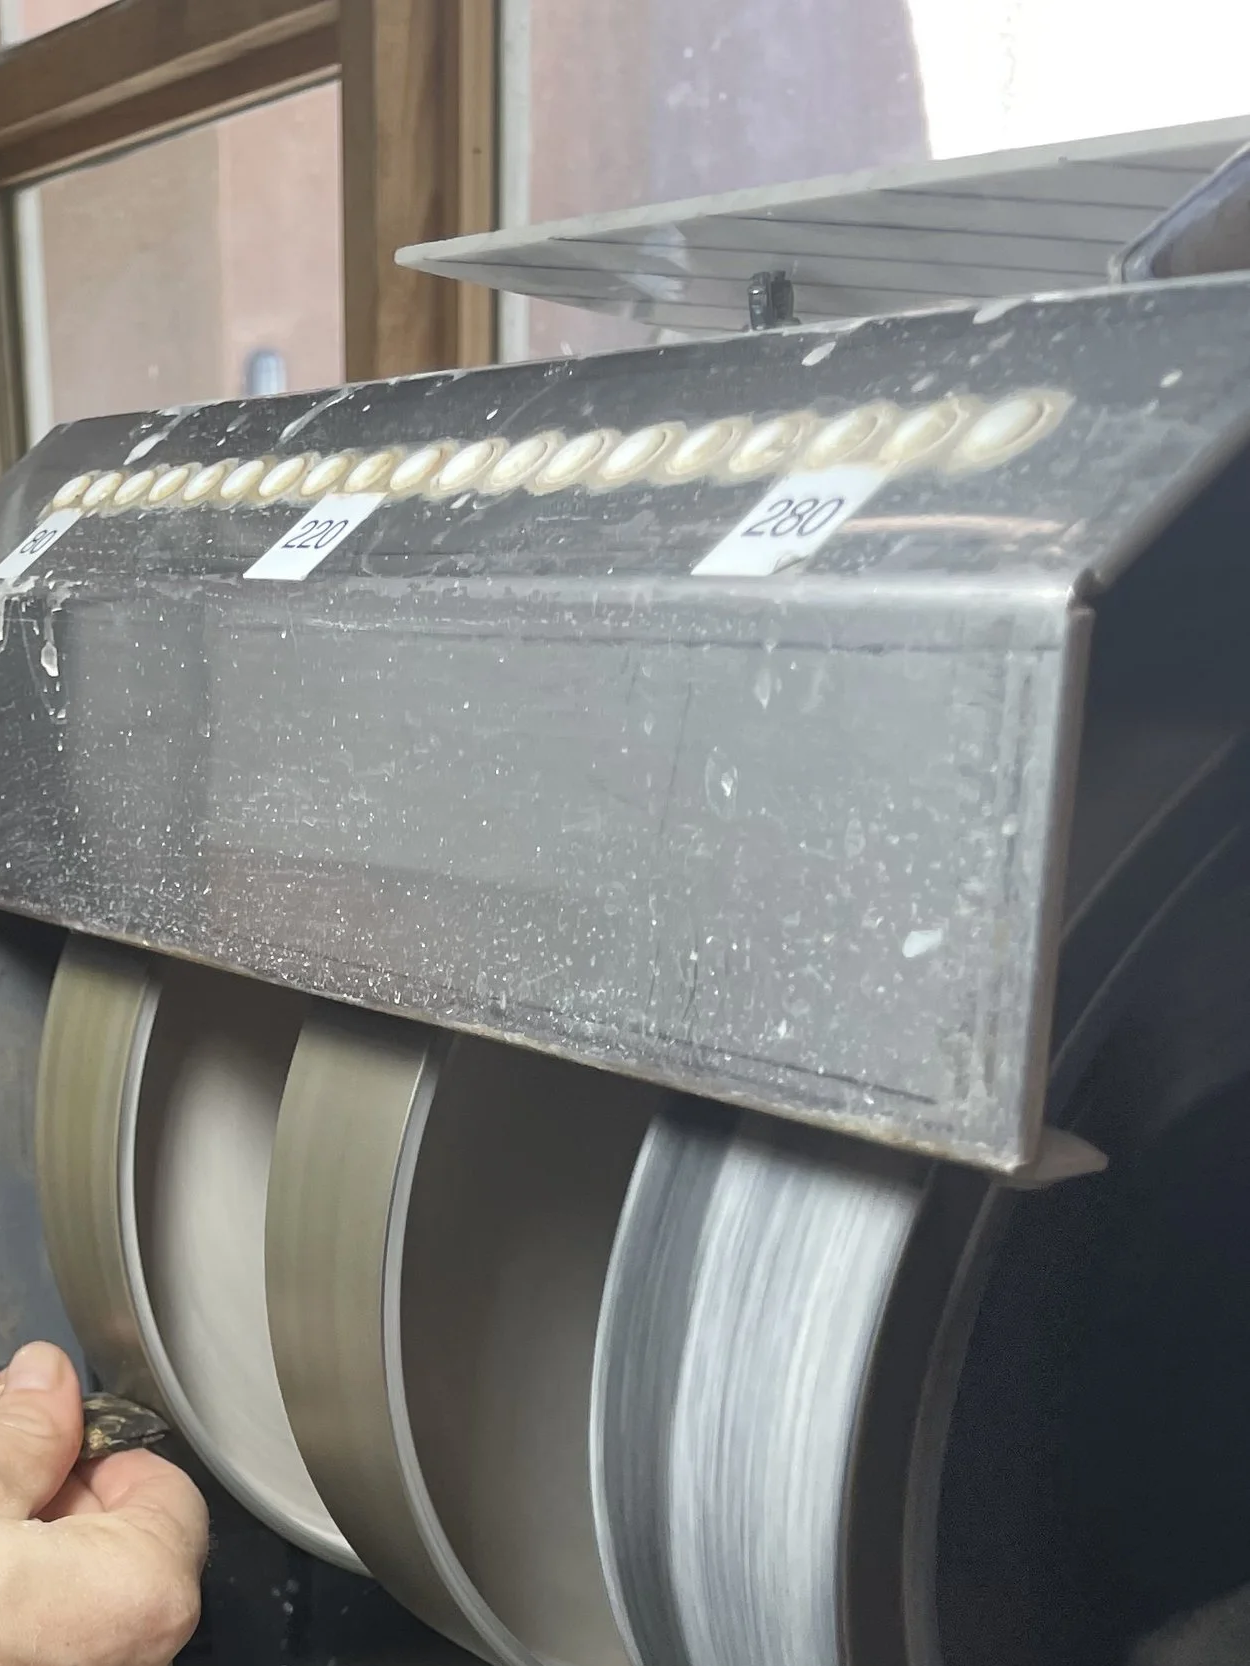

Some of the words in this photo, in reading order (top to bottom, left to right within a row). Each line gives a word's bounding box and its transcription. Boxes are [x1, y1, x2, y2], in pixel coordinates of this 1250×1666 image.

[742, 498, 845, 537] 280
[19, 529, 57, 554] 80
[281, 519, 349, 549] 220
